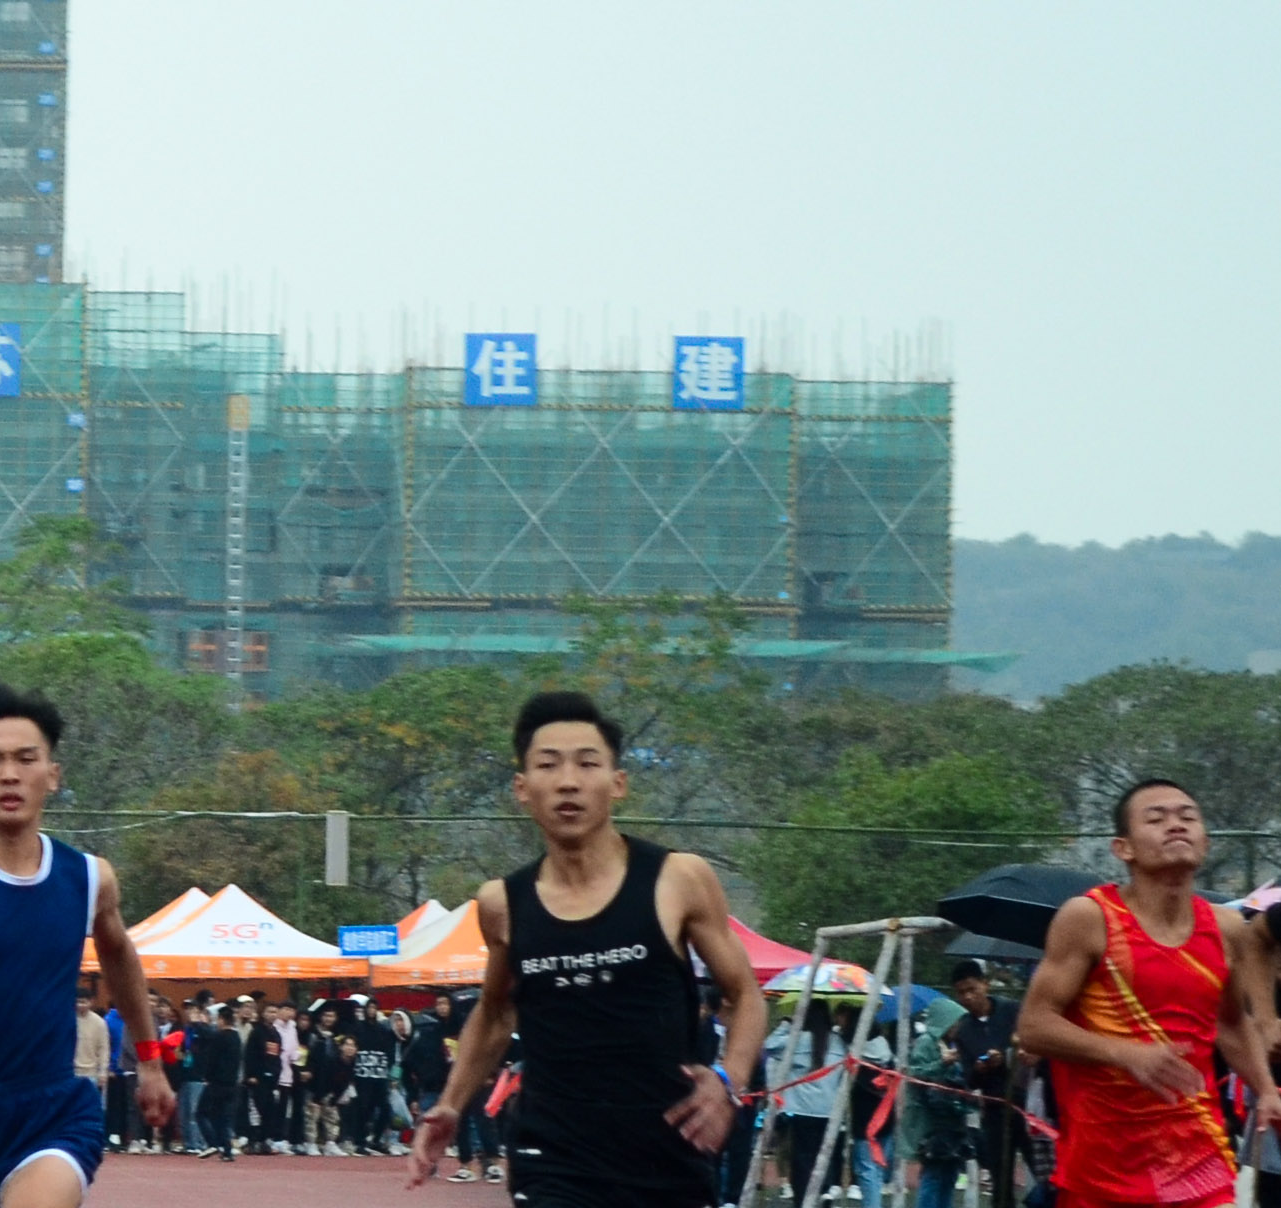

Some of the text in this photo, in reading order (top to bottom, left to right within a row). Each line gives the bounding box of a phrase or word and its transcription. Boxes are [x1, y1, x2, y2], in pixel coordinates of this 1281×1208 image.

[521, 944, 647, 975] BEAT THE HERO
